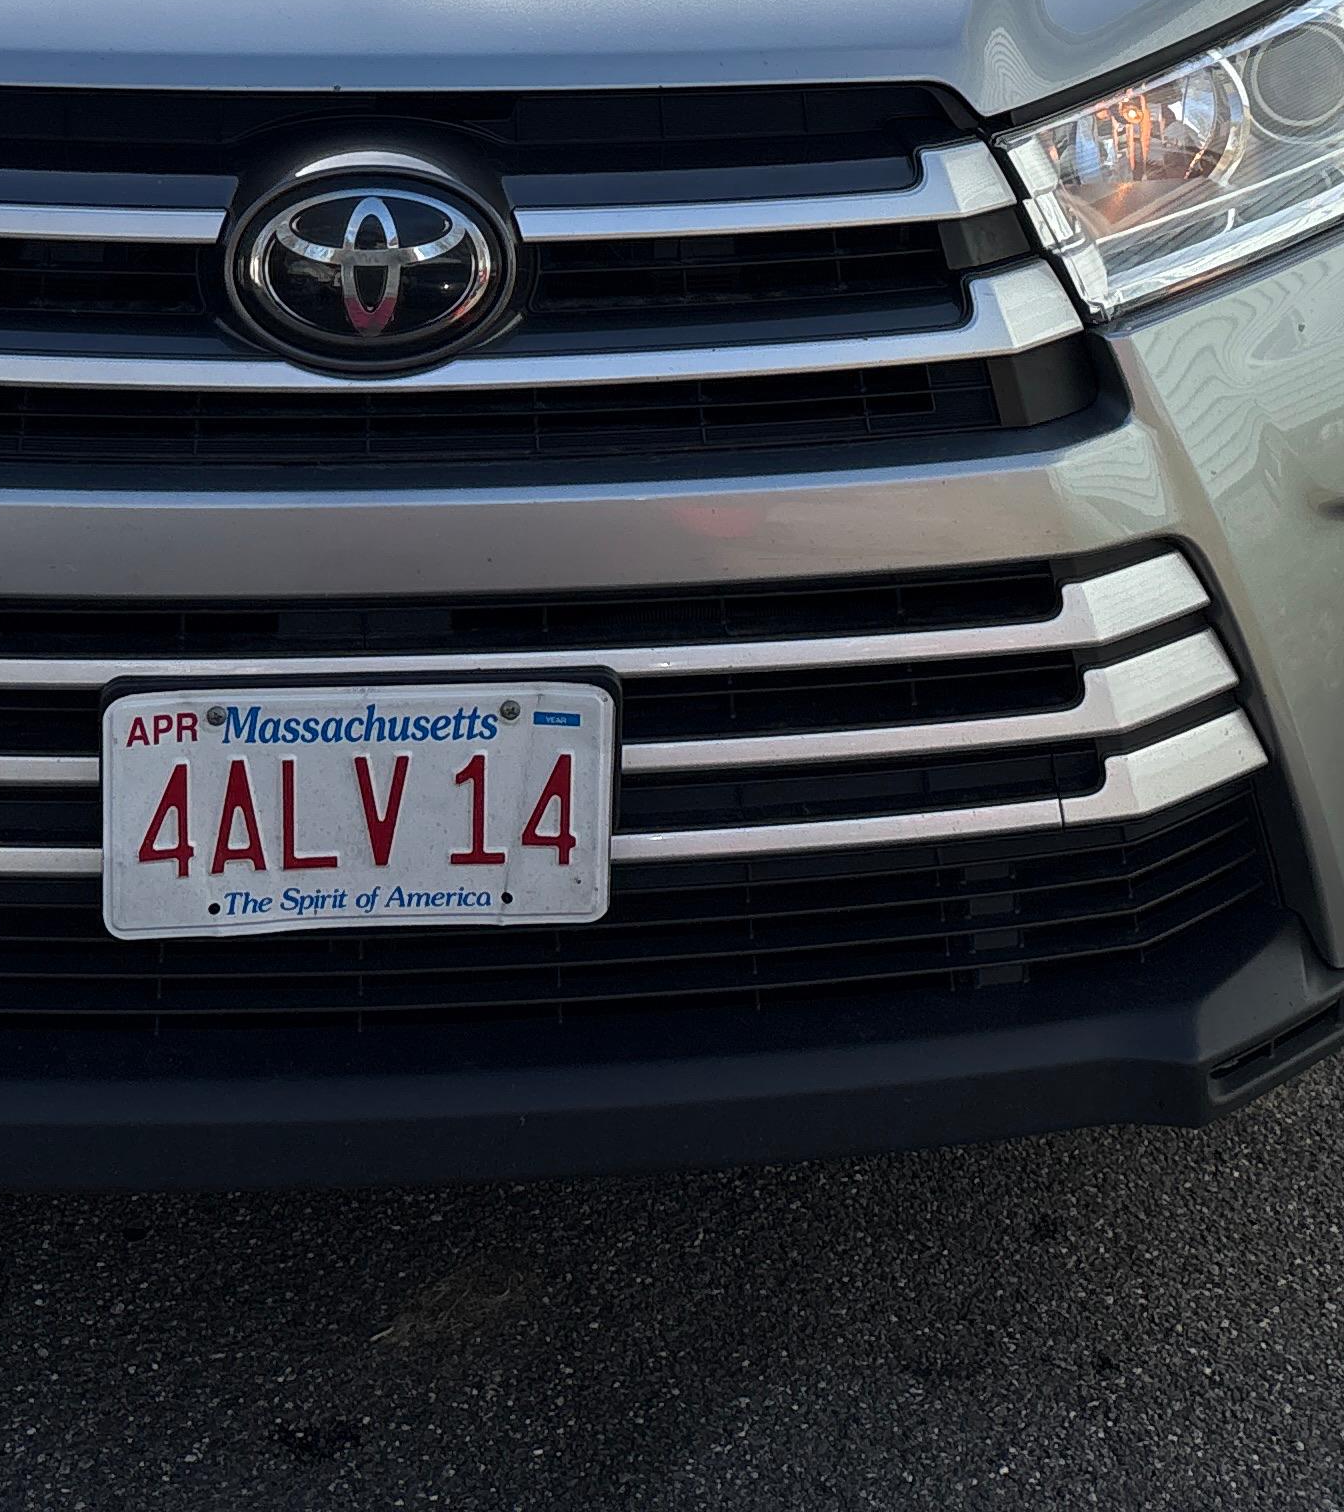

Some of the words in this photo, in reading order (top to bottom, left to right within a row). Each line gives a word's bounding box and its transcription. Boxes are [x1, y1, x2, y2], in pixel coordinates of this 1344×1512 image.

[126, 711, 199, 746] APR
[223, 704, 498, 745] Massachusetts
[223, 890, 273, 916] The
[280, 886, 348, 915] Spirit
[355, 886, 382, 913] of
[384, 886, 492, 909] America
